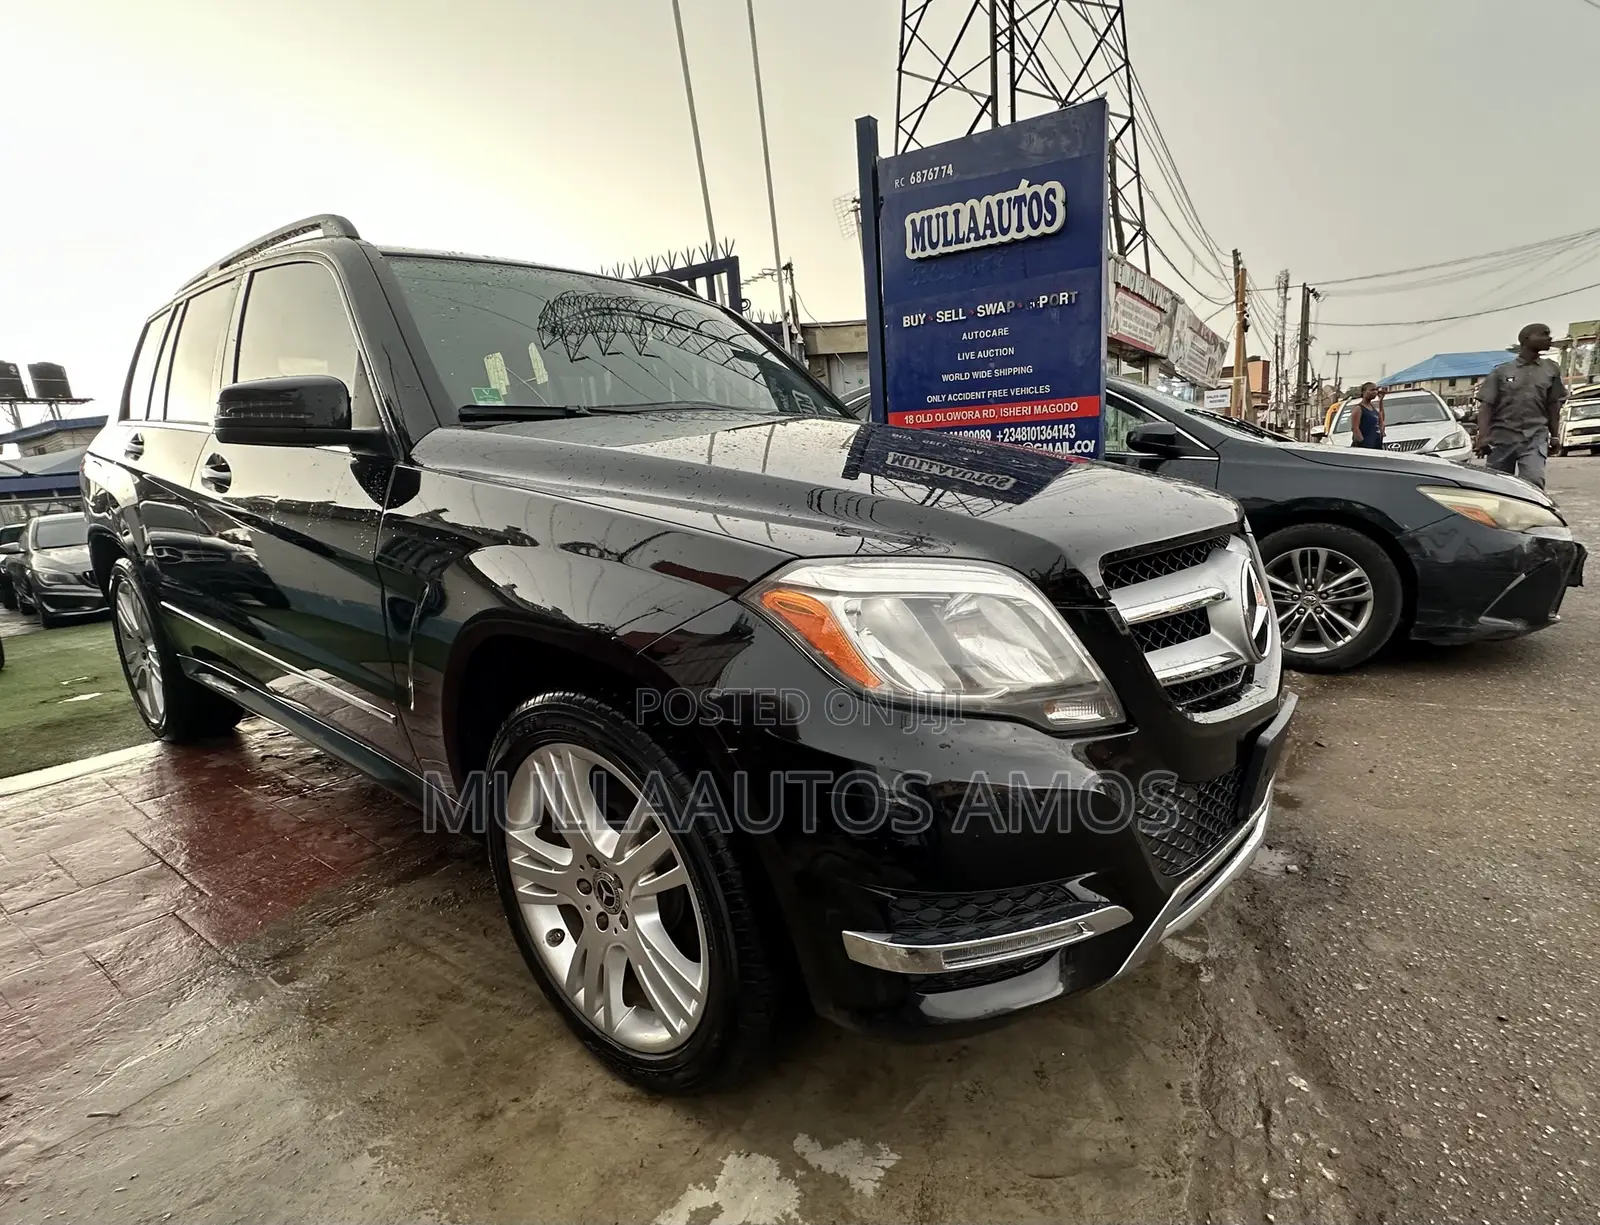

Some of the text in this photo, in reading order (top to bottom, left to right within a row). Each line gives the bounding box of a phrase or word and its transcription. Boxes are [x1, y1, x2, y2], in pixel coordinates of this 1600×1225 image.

[895, 163, 953, 188] RC 6876774
[909, 186, 1058, 254] MULLAAUTOS
[902, 313, 927, 328] BUY
[936, 308, 967, 323] SELL
[976, 301, 1015, 318] SWAP
[962, 327, 1010, 341] AUTOCARE
[957, 347, 1015, 361] LIVE AUCTION
[941, 366, 1033, 383] WORLD WIDE SHIPPING
[926, 385, 1051, 404] ONLY ACCIDENT FREE VEHICLES
[904, 402, 1079, 425] 18 OLD OLOWORA RD, ISHERI MAGODO
[996, 423, 1076, 442] +2348101364143
